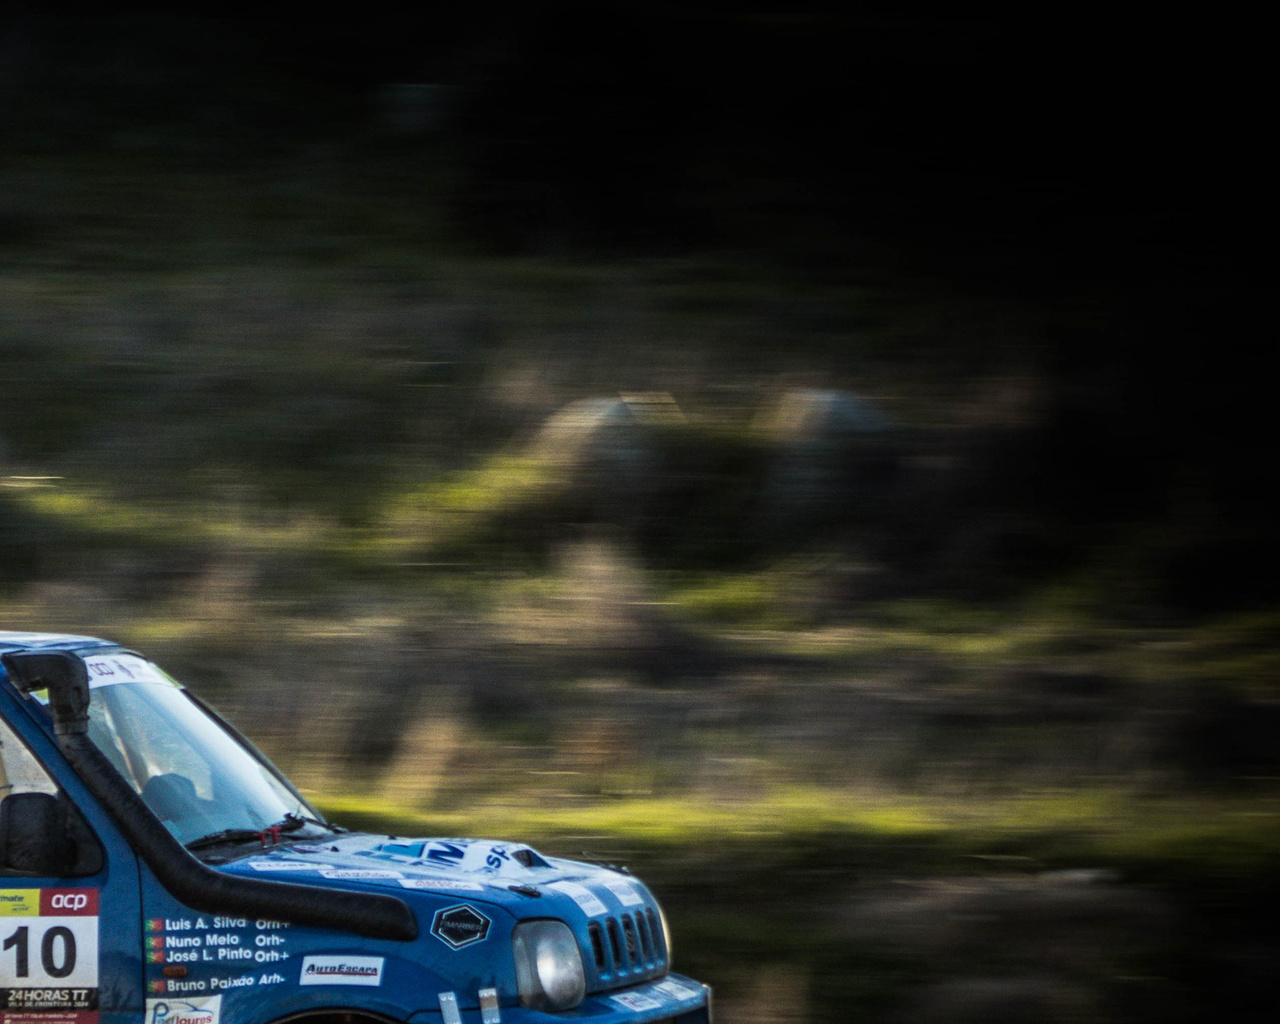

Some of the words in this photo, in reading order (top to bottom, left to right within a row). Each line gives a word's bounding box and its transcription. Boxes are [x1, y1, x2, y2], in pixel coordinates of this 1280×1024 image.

[51, 893, 87, 911] acp
[195, 918, 208, 930] A.
[213, 916, 247, 929] Silva
[165, 936, 201, 948] Nuno
[205, 934, 239, 946] Melo
[3, 925, 77, 978] 10
[166, 949, 198, 963] José
[203, 949, 213, 961] L.
[218, 947, 252, 960] Pinto
[167, 979, 205, 991] Bruno
[210, 976, 254, 990] Paixão
[71, 990, 88, 1001] TT
